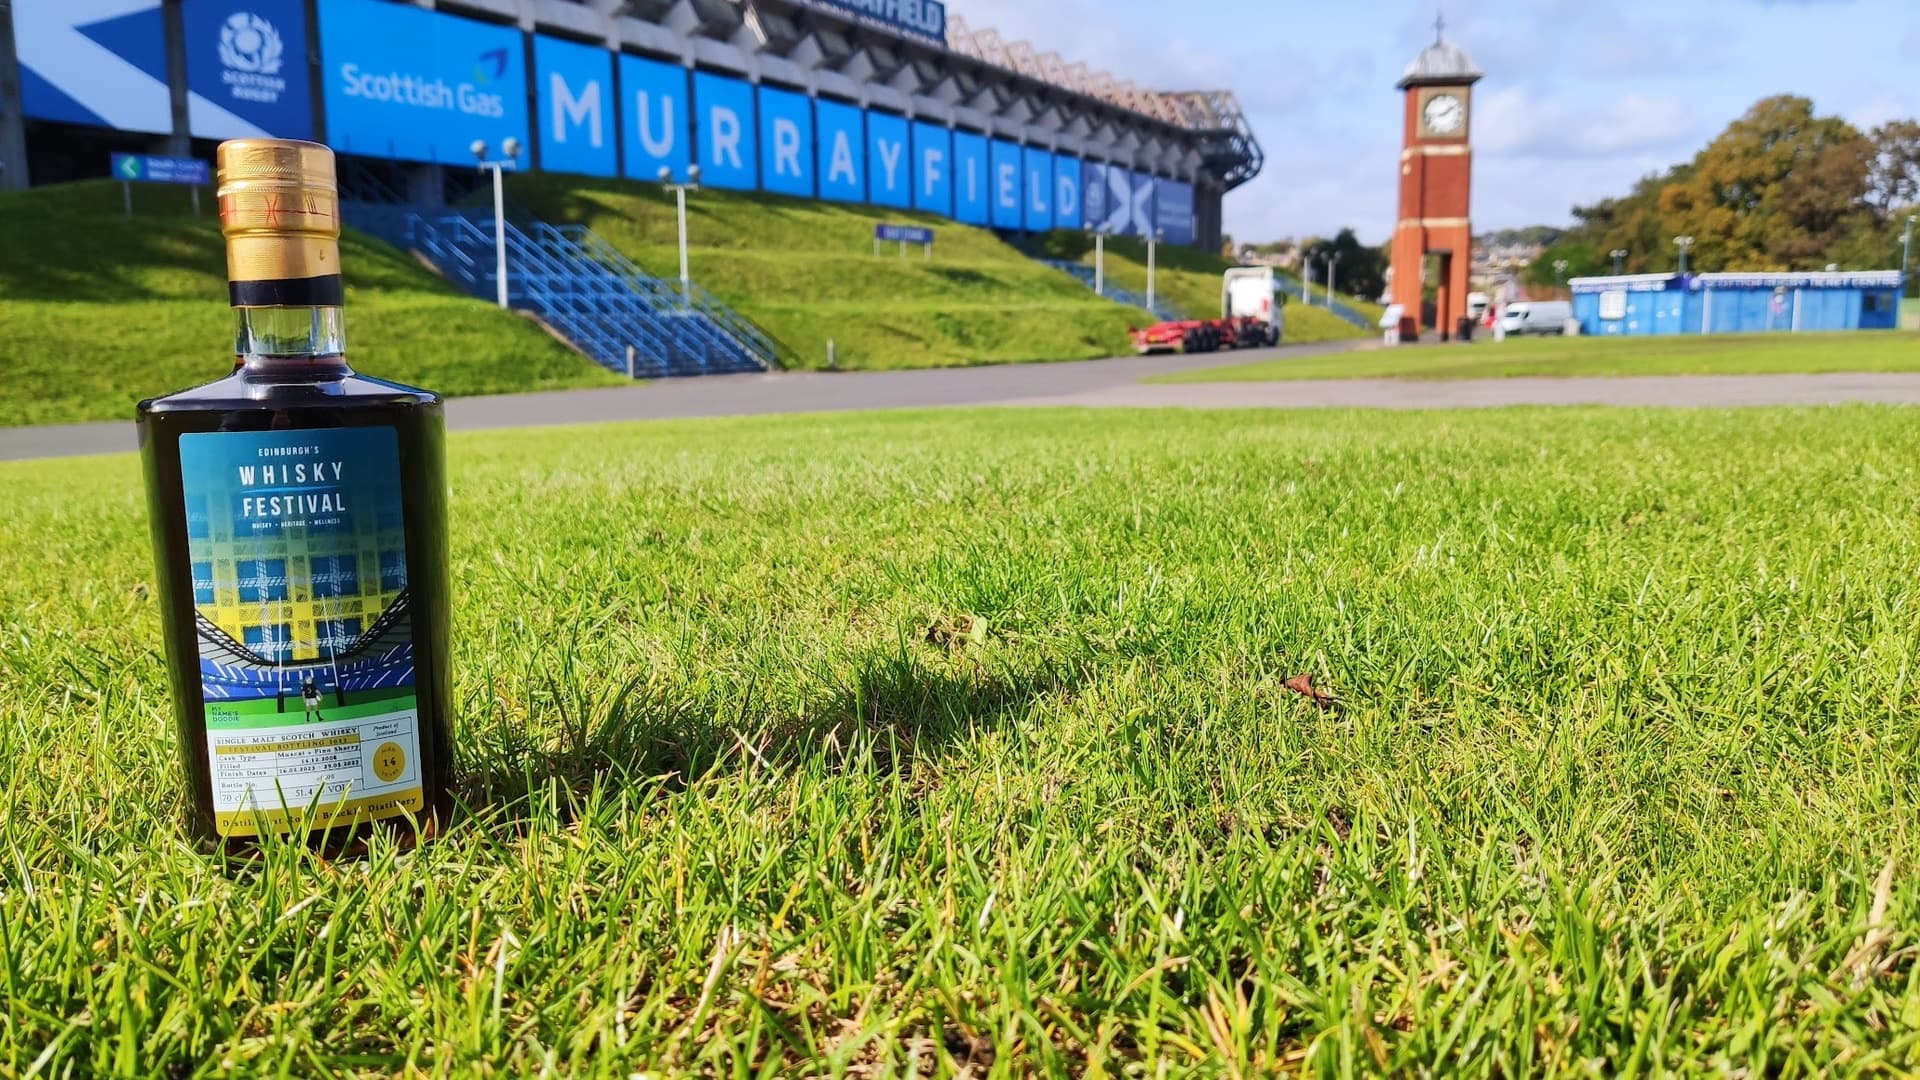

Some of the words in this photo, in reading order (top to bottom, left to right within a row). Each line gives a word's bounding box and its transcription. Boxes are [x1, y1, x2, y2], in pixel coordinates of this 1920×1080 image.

[341, 62, 454, 110] Scottish
[456, 82, 504, 118] Gas
[551, 71, 1077, 216] MURRAYFIELD
[258, 446, 320, 457] EDINBURGH'S
[239, 461, 342, 486] WHISKY
[243, 493, 346, 518] FESTIVAL
[228, 744, 272, 753] FESTIVAL
[277, 740, 325, 750] BOTTLING
[281, 733, 315, 741] SCOTCH
[322, 727, 358, 737] WHISKY
